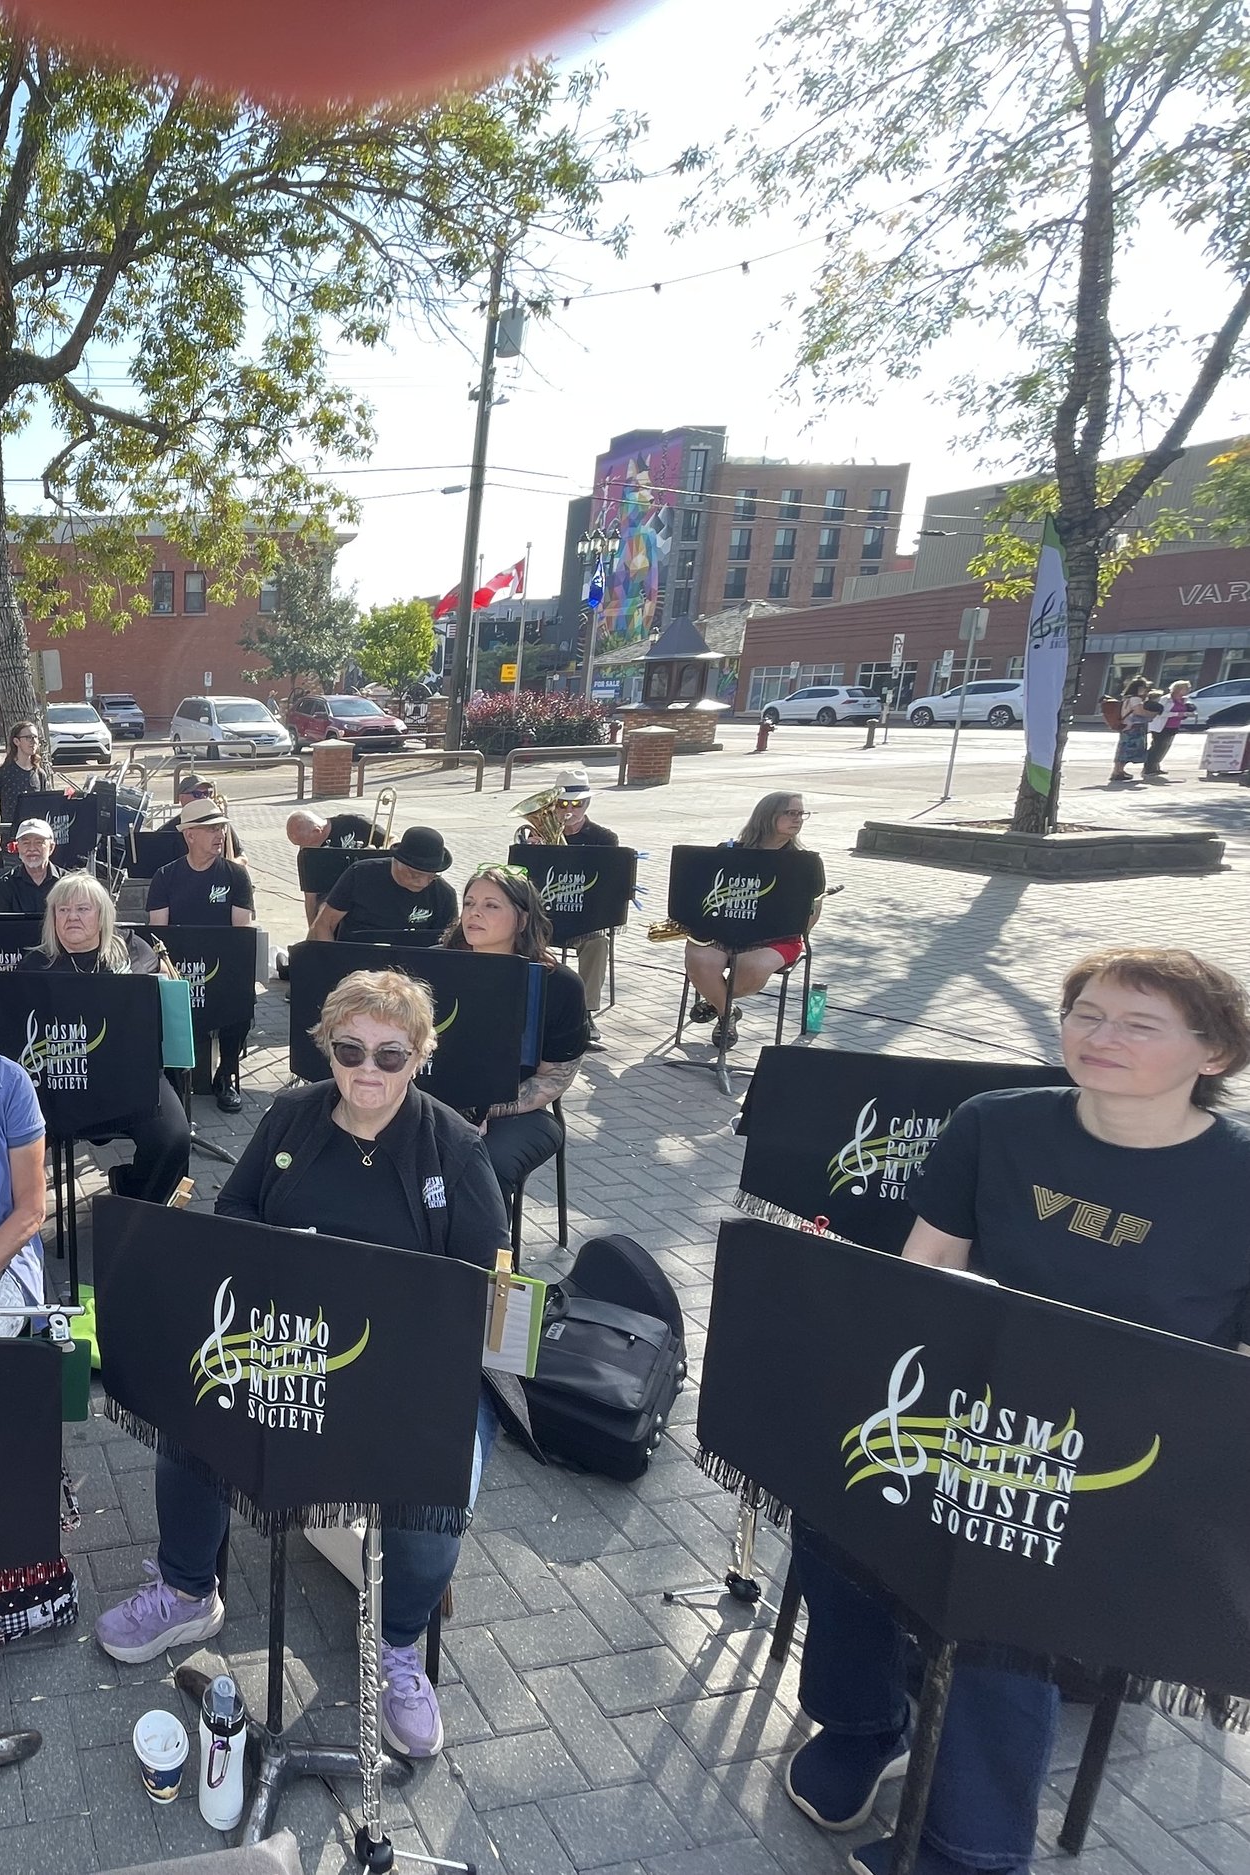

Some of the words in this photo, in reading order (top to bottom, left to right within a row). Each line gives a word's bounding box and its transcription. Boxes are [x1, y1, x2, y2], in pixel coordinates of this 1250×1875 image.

[558, 873, 586, 884] COSMO
[729, 877, 761, 888] COSMO
[557, 893, 584, 903] MUSIC
[726, 899, 758, 910] MUSIC
[555, 904, 583, 912] SOCIETY
[724, 910, 756, 920] SOCIETY
[175, 962, 206, 973] COSMO
[190, 986, 206, 997] SIC
[45, 1024, 87, 1040] COSMO
[46, 1042, 87, 1055] POLITAN
[47, 1058, 88, 1074] MUSIC
[47, 1077, 88, 1090] SOCIETY
[890, 1117, 940, 1138] COSM
[250, 1307, 330, 1348] COSMO
[250, 1339, 328, 1374] POLITAN
[249, 1364, 326, 1408] MUSIC
[248, 1399, 325, 1435] SOCIETY
[949, 1388, 1084, 1461] COSMO
[943, 1427, 1076, 1495] POLITAN
[936, 1458, 1070, 1533] MUSIC
[931, 1499, 1062, 1567] SOCIETY
